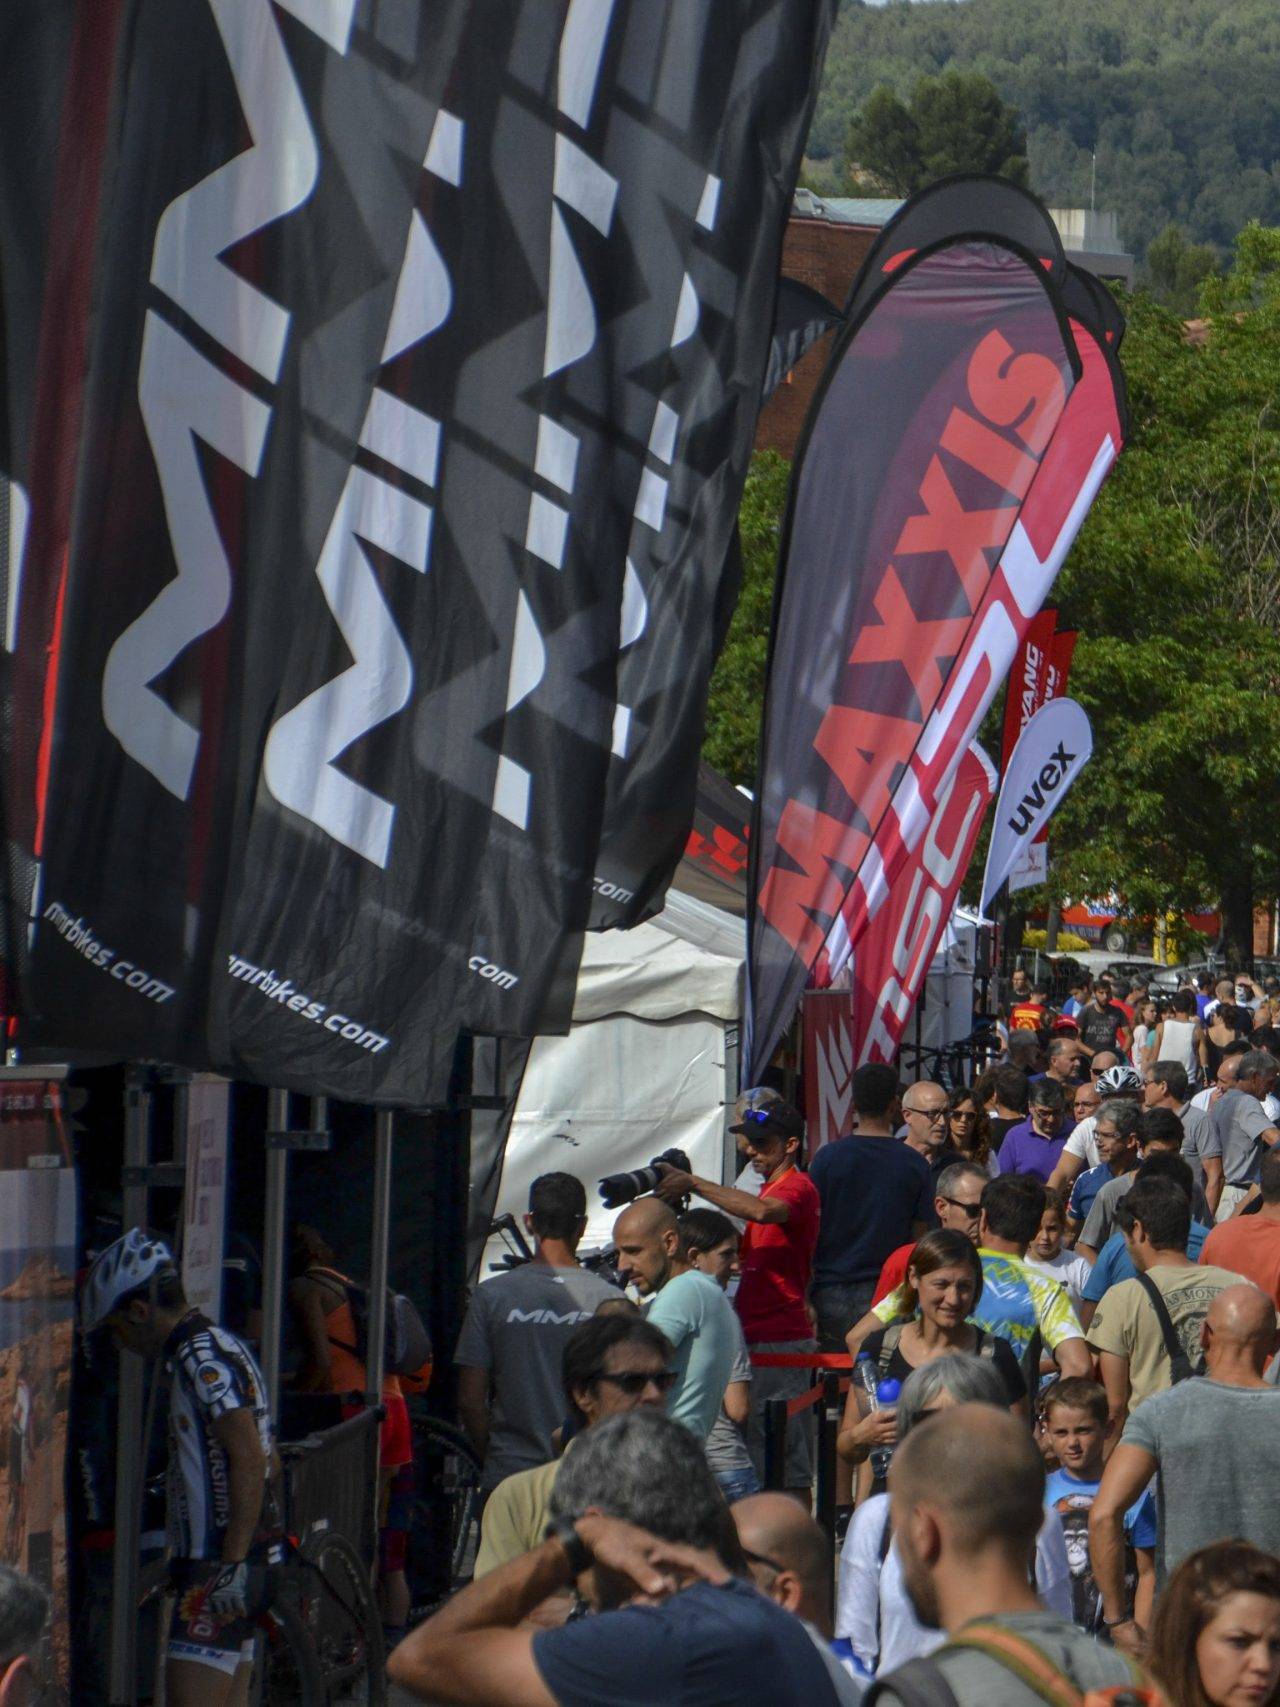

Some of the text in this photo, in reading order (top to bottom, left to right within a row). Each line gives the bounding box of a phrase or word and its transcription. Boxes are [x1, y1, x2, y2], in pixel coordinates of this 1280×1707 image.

[757, 328, 1066, 970] MAXXIS
[1007, 740, 1077, 837] uvex
[227, 954, 391, 1053] mrbikes.com
[1184, 1288, 1222, 1302] MON
